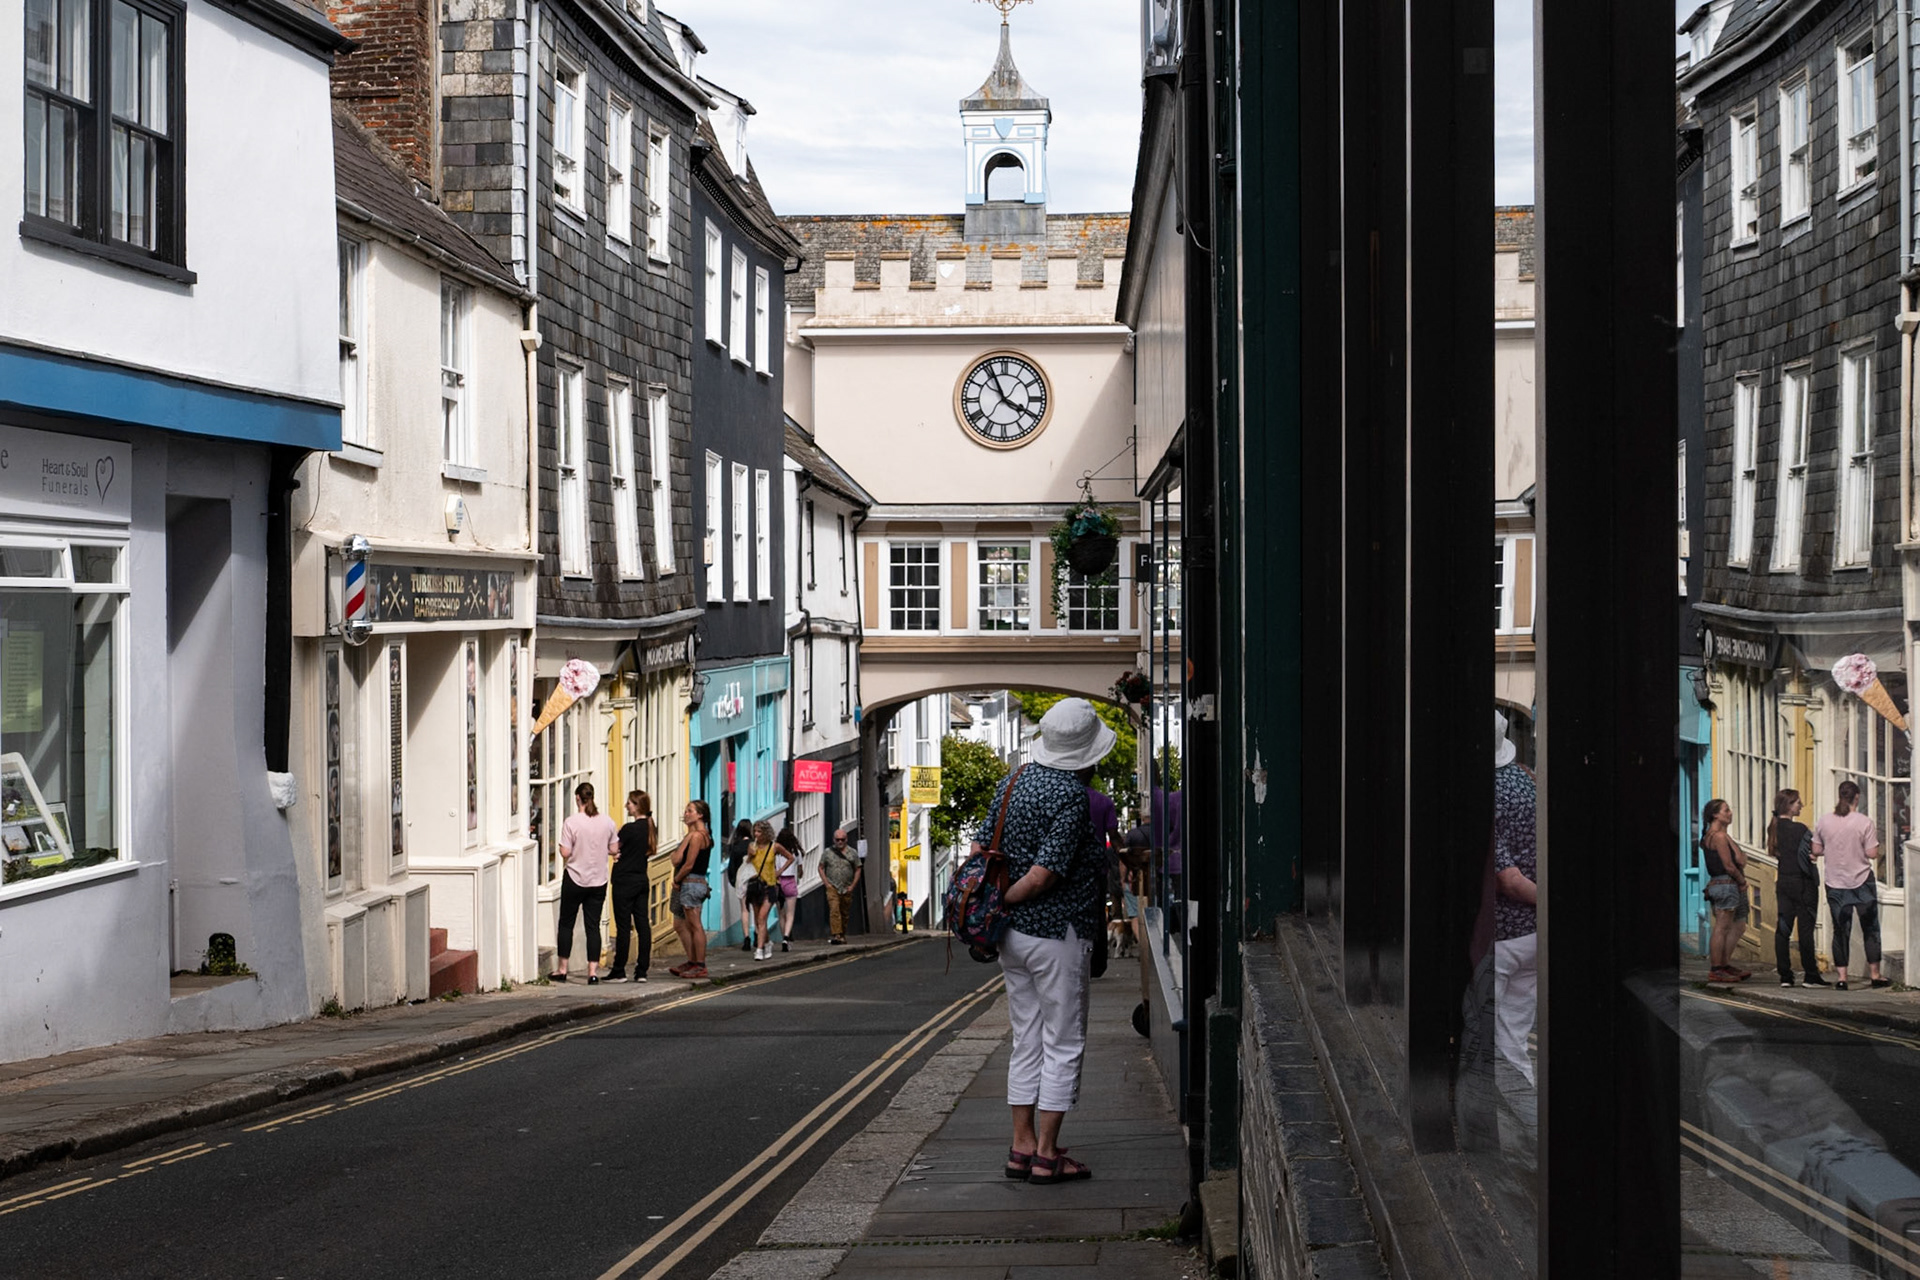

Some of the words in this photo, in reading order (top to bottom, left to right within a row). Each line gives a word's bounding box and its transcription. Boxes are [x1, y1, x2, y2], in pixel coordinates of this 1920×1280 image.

[42, 458, 64, 476] Heart
[71, 461, 88, 478] Soul
[42, 477, 88, 496] Funerals
[411, 573, 442, 593] TURKISH
[443, 575, 465, 593] STYLE
[799, 769, 828, 780] ATOM
[912, 780, 938, 788] HOUSE
